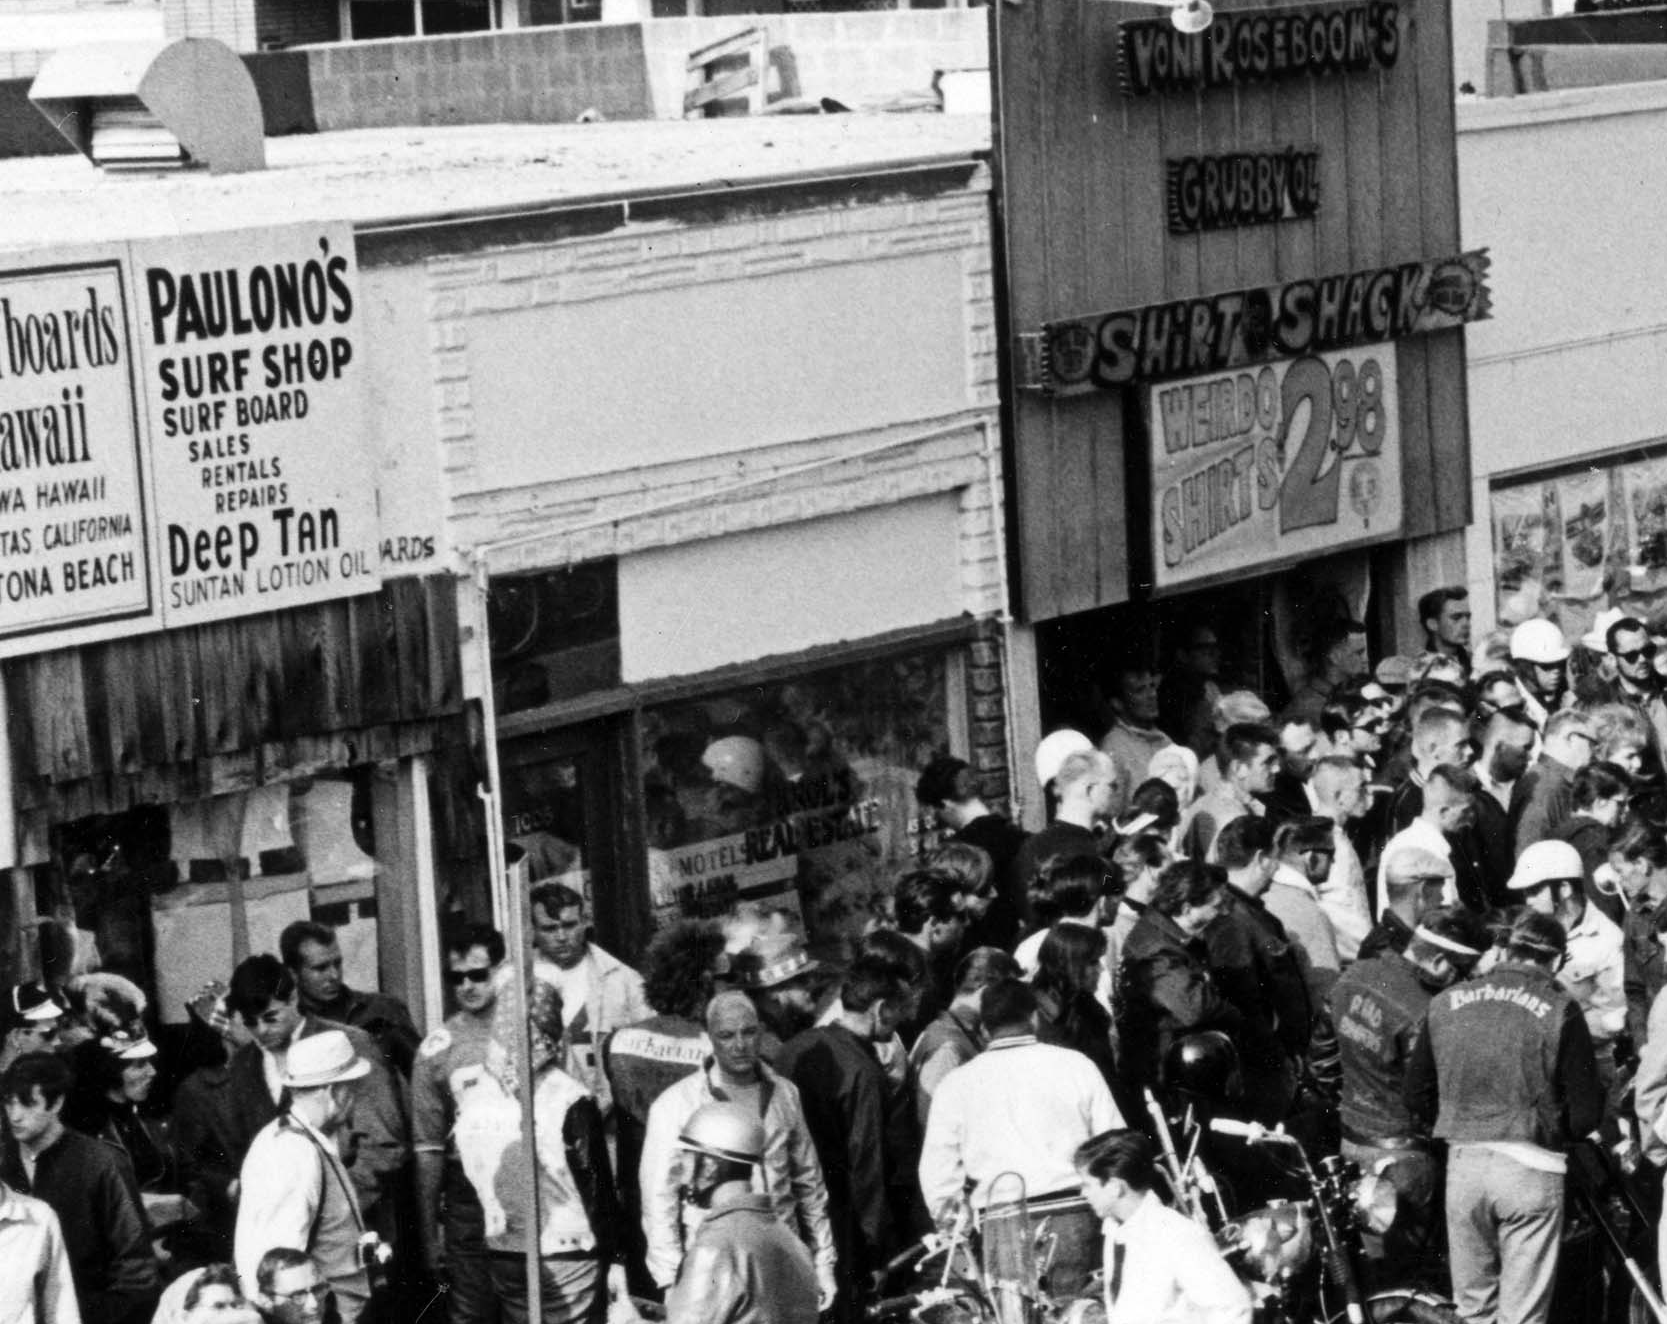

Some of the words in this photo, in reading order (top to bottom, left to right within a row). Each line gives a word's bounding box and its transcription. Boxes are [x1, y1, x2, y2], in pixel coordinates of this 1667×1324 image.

[1181, 155, 1287, 221] GRUBBY
[146, 237, 354, 345] PAULONO'S
[0, 286, 119, 378] boards
[1101, 291, 1246, 382] SHIRT
[1276, 264, 1428, 357] SHACK
[159, 349, 251, 401] SURF
[262, 337, 353, 388] SHOP
[163, 400, 227, 437] SURF
[236, 389, 309, 427] BOARD
[1160, 365, 1278, 455] WEIRDO
[188, 434, 250, 463] SALES
[201, 458, 282, 489] RENTALS
[37, 476, 106, 509] HAWAII
[214, 483, 289, 514] REPAIRS
[1162, 436, 1279, 568] SHIRTS
[43, 513, 132, 550] CALIFORNIA
[168, 522, 260, 576] Deep
[379, 535, 436, 563] ARDS
[64, 551, 135, 593] BEACH
[170, 575, 245, 609] SUNTAN
[256, 560, 333, 594] LOTION
[340, 551, 371, 578] OIL
[1451, 983, 1553, 1019] Barbarians
